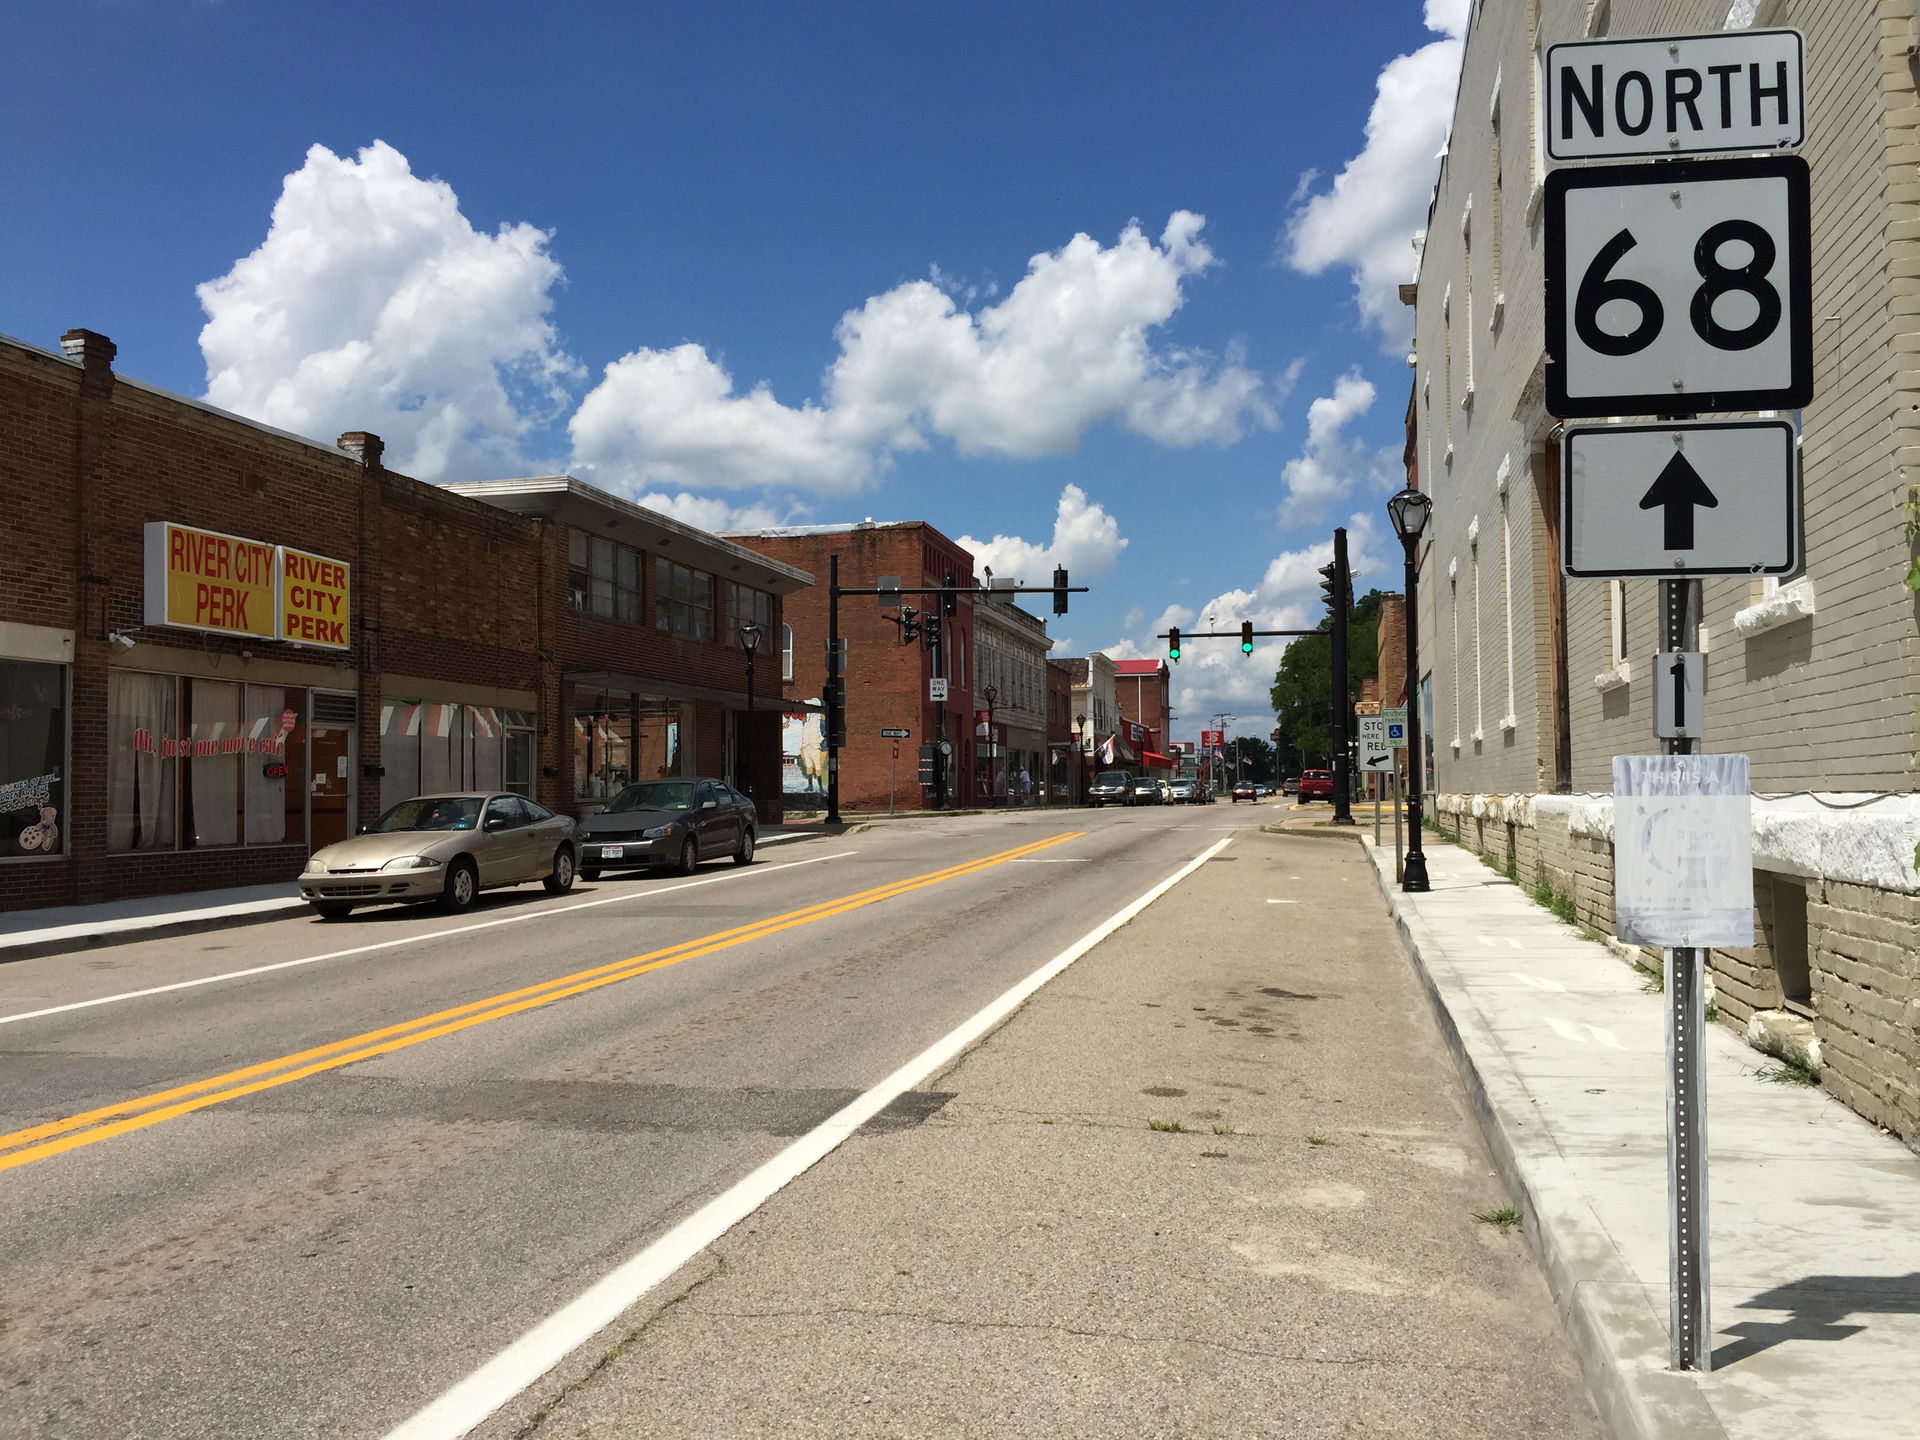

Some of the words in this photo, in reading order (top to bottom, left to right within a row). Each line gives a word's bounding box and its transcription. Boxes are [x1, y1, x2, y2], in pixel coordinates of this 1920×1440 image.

[1561, 60, 1789, 140] NORTH
[1574, 219, 1782, 357] 68
[171, 529, 230, 580] RIVER
[235, 542, 274, 587] CITY
[285, 553, 346, 590] RIVER
[195, 583, 250, 630] PERK
[290, 585, 342, 616] CITY
[286, 613, 345, 644] PERK
[1669, 662, 1685, 728] 1
[1363, 722, 1383, 731] STO
[132, 728, 157, 757] Oh,
[161, 733, 192, 760] just
[194, 738, 218, 756] one
[221, 736, 255, 755] more
[266, 766, 290, 778] OPEN
[1641, 771, 1680, 784] THIS
[1686, 771, 1700, 784] IS
[1706, 771, 1720, 784] A
